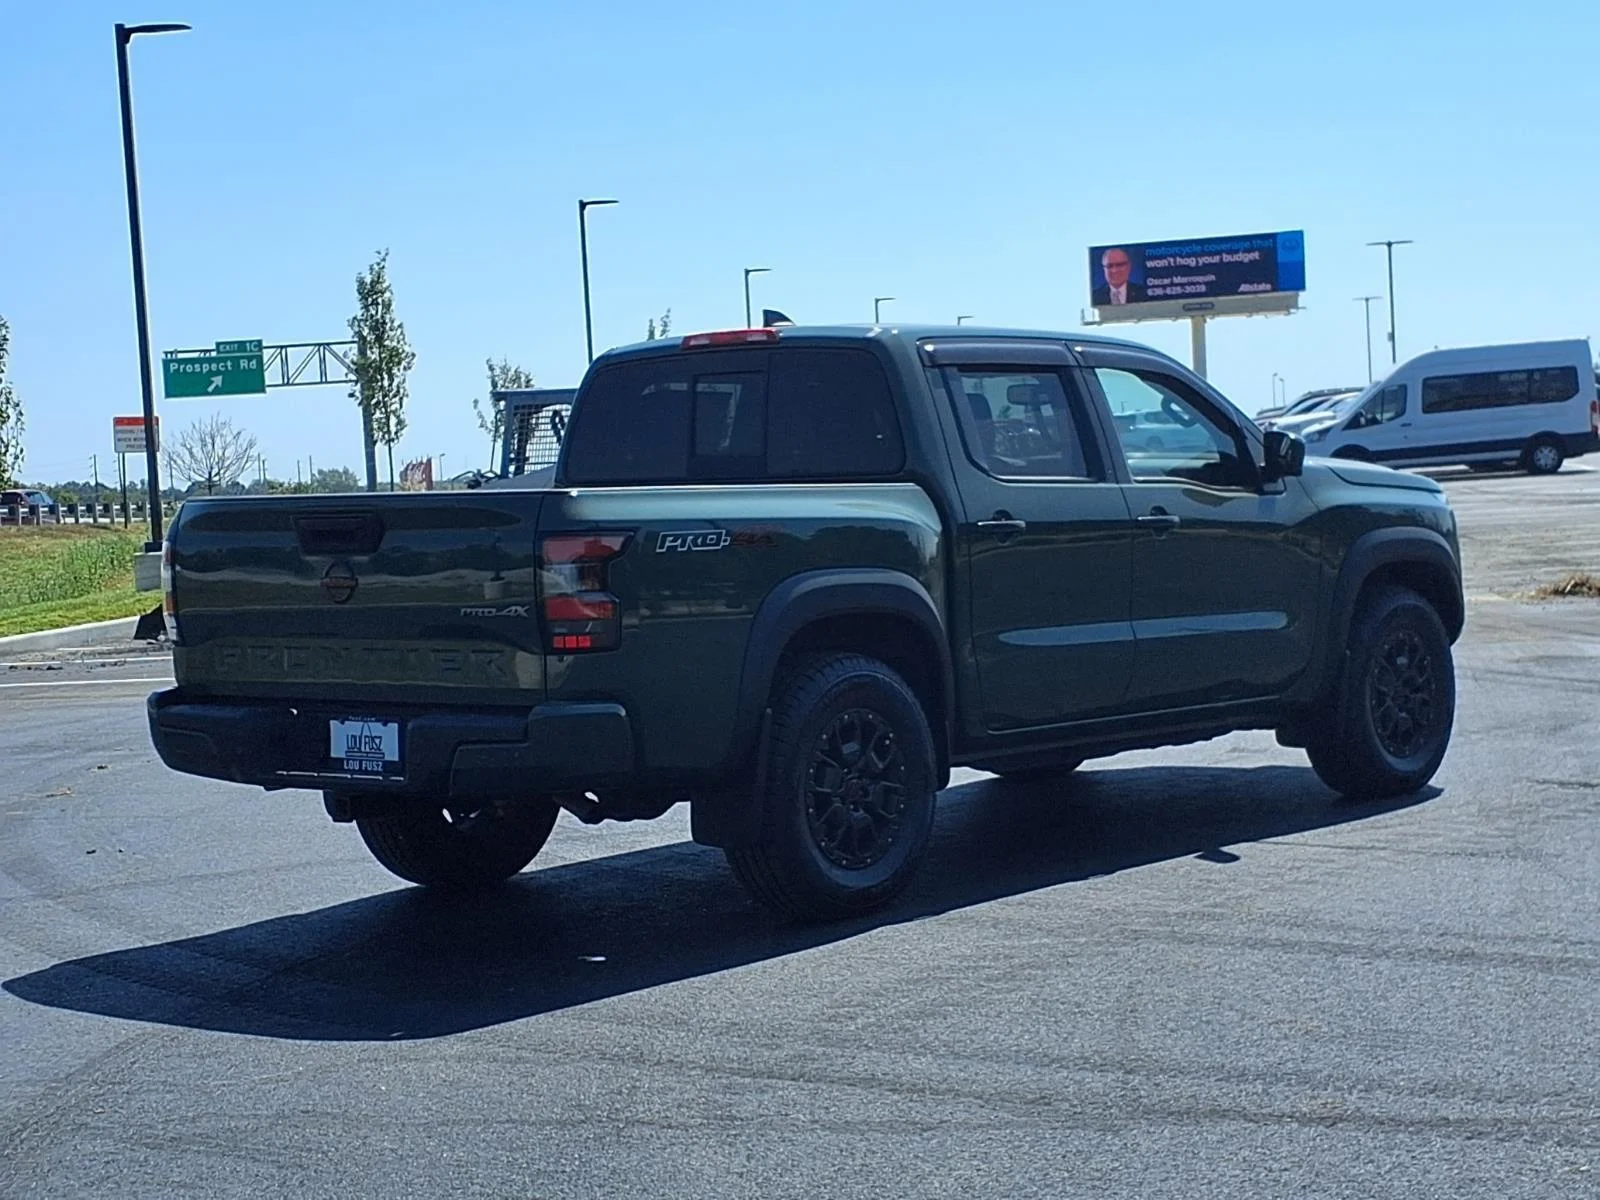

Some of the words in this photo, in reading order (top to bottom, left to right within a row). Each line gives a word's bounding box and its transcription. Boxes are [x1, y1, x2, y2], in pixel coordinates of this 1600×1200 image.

[1145, 244, 1201, 256] motorcycle
[1203, 240, 1250, 253] coverage
[1252, 238, 1273, 248] that
[1145, 257, 1175, 268] won't
[1176, 256, 1197, 267] hog
[1197, 254, 1221, 267] your
[1222, 250, 1260, 263] budget
[1146, 277, 1171, 286] Oscar
[220, 343, 239, 352] EXIT
[246, 341, 260, 352] 1C
[169, 360, 233, 374] Prospect
[239, 359, 257, 370] Rd
[343, 759, 360, 770] LOU
[361, 760, 383, 771] FUSZ
